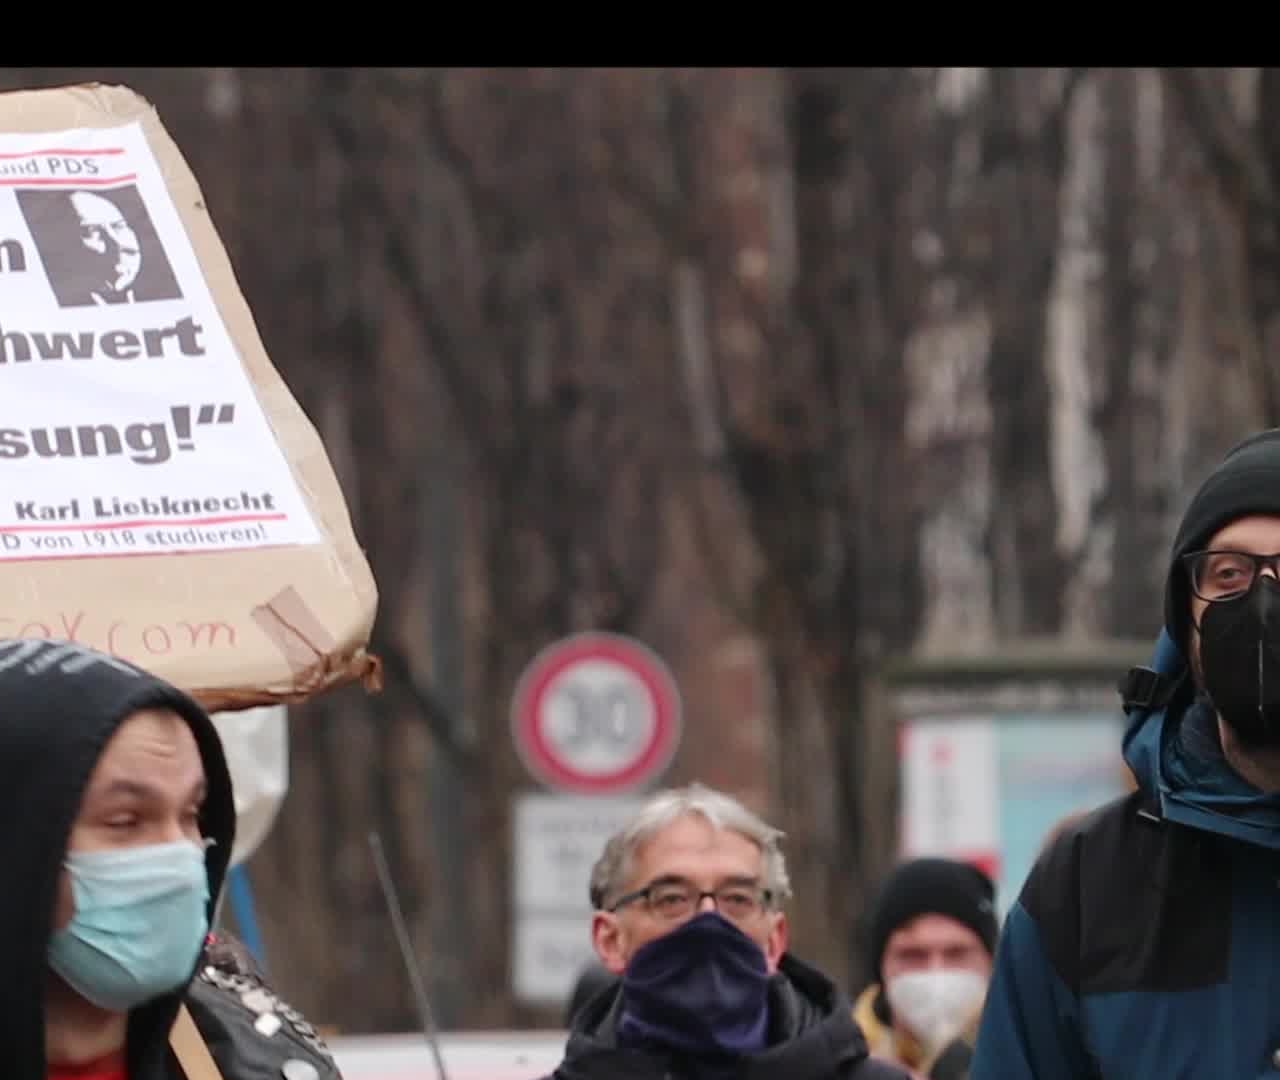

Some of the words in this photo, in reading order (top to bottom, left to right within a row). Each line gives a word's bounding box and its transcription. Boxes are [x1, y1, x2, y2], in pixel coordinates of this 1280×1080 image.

[46, 157, 100, 176] PDS
[13, 498, 80, 522] Karl
[92, 490, 276, 518] Liebknecht
[29, 533, 72, 551] von
[82, 529, 136, 548] 1918
[144, 522, 268, 547] studieren!
[562, 681, 644, 750] 30
